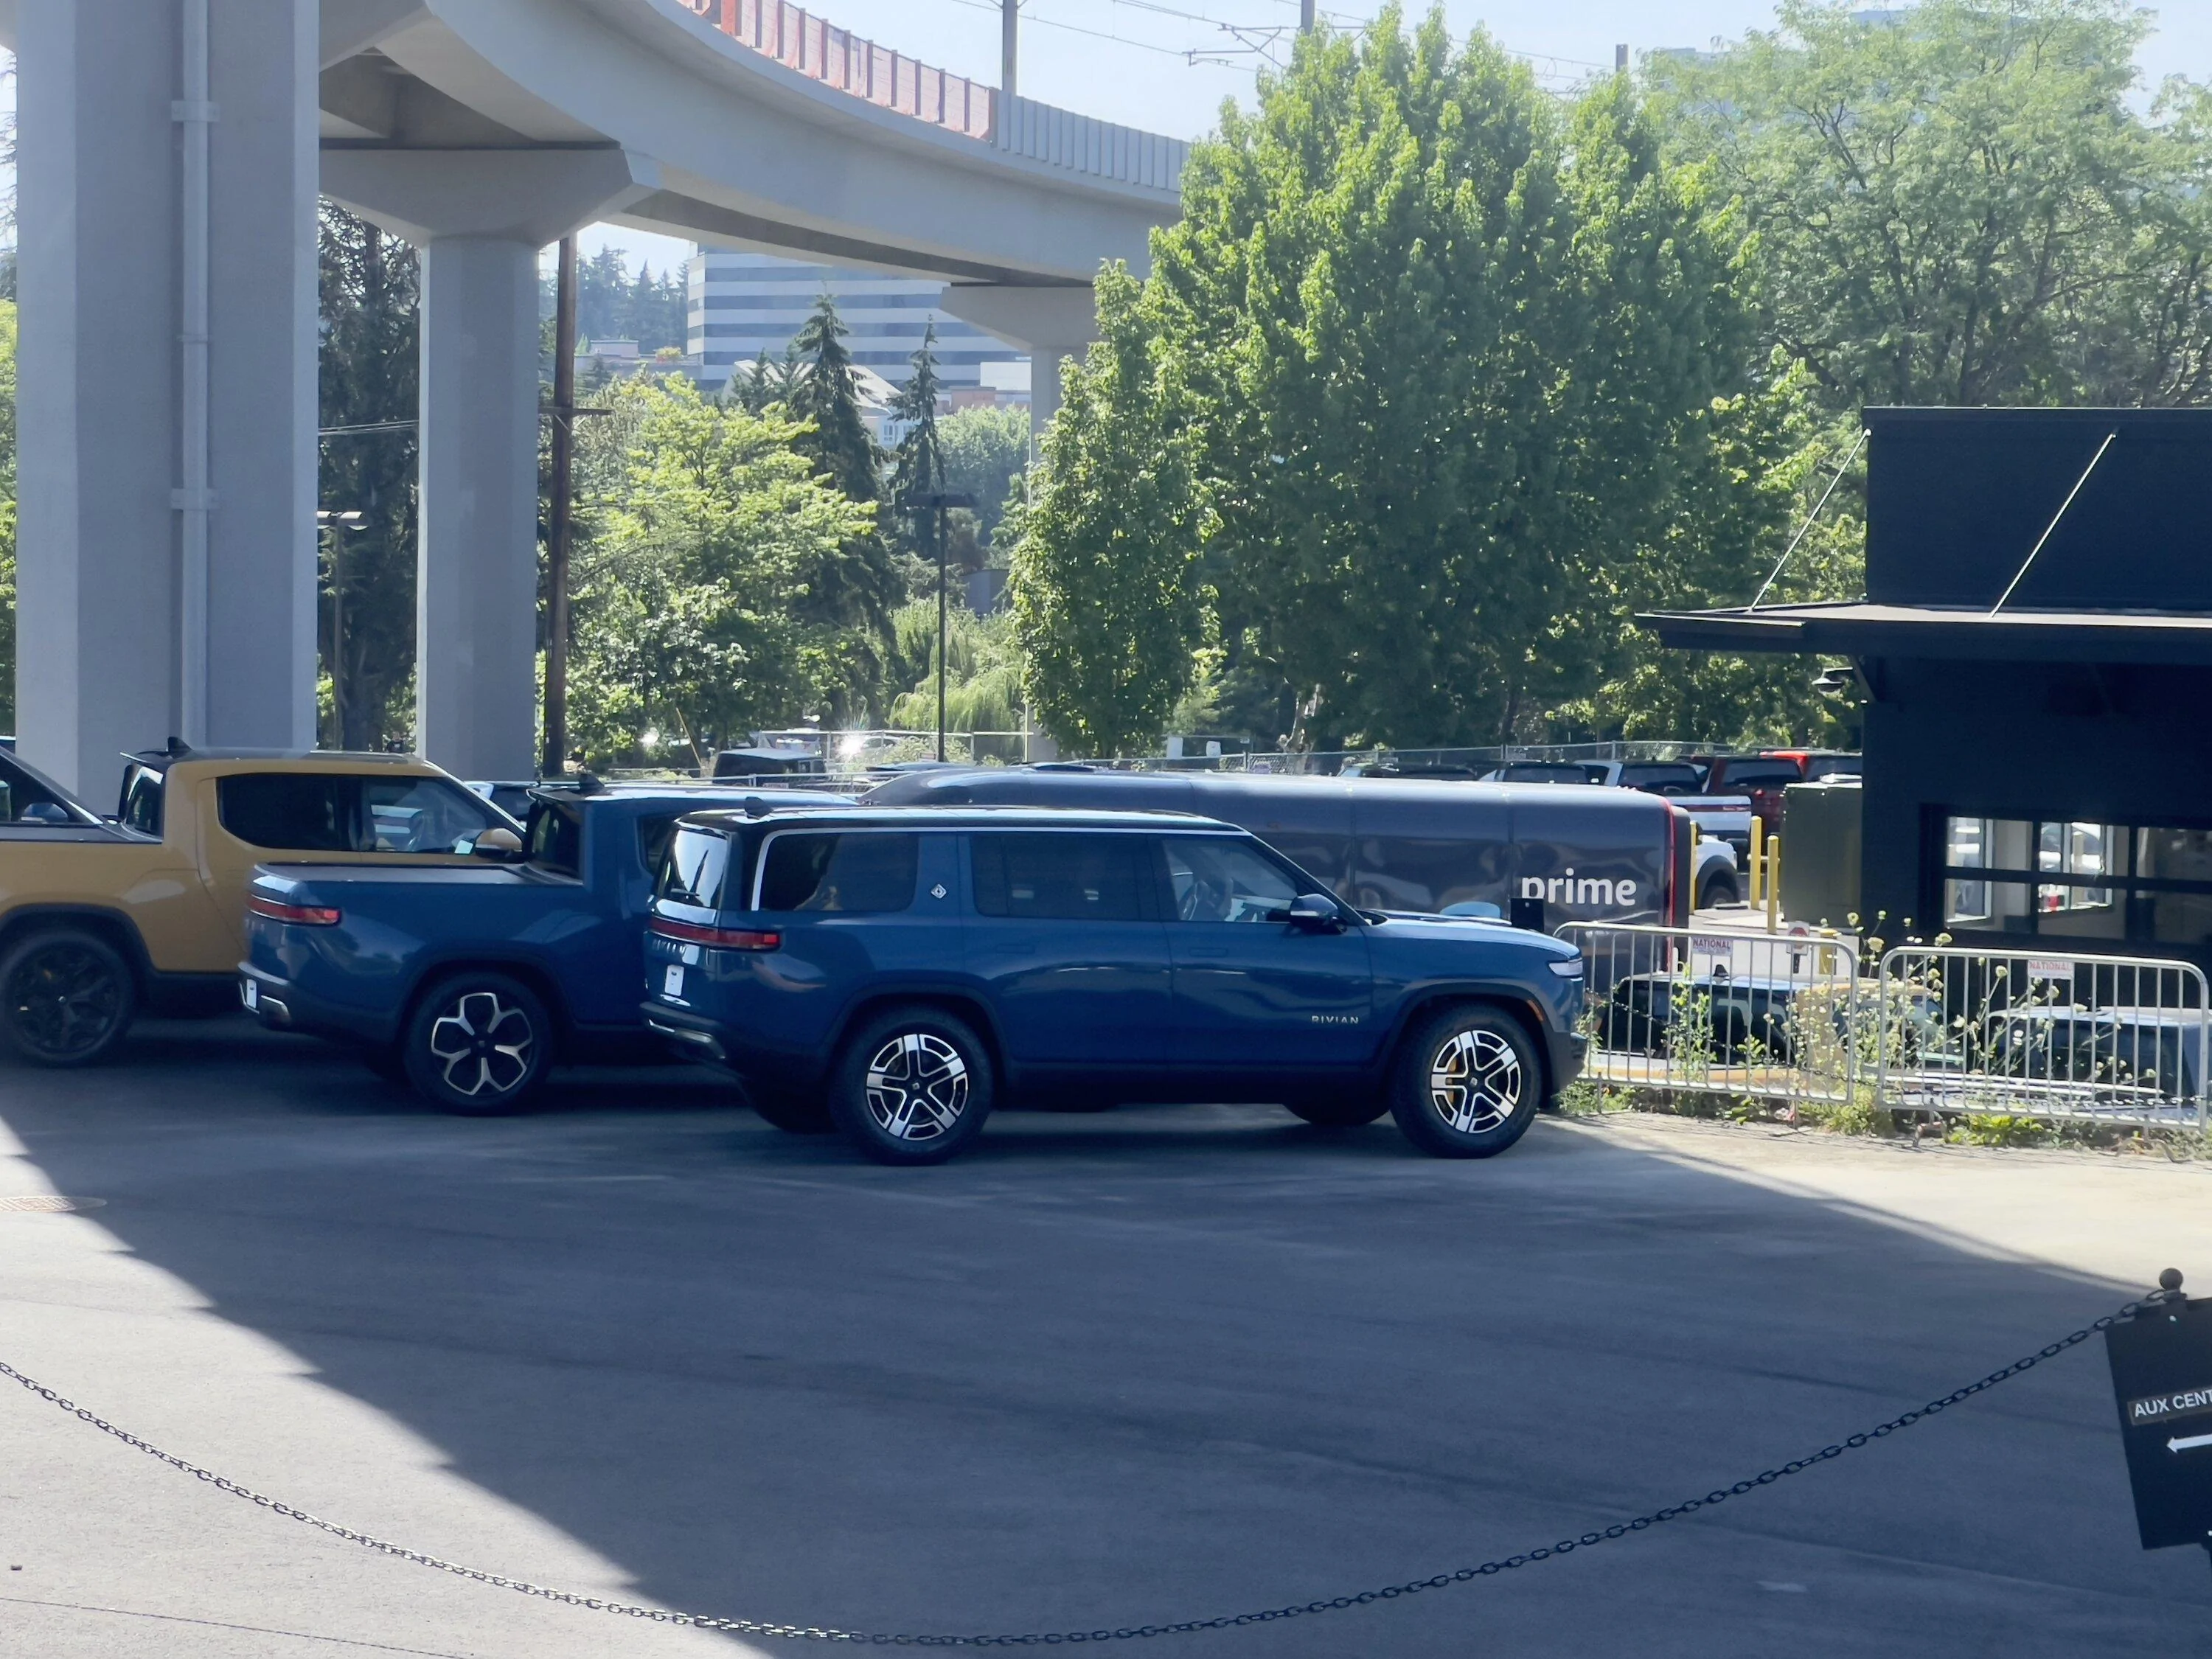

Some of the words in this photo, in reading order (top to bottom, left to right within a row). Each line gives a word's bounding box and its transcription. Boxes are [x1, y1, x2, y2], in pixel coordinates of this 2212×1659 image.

[1521, 868, 1637, 905] prime
[1693, 938, 1731, 948] NATIONAL
[2029, 961, 2071, 971] NATIONAL
[1312, 1015, 1359, 1023] RIVIAN
[2135, 1398, 2170, 1417] AUX
[2172, 1389, 2212, 1409] CENT
